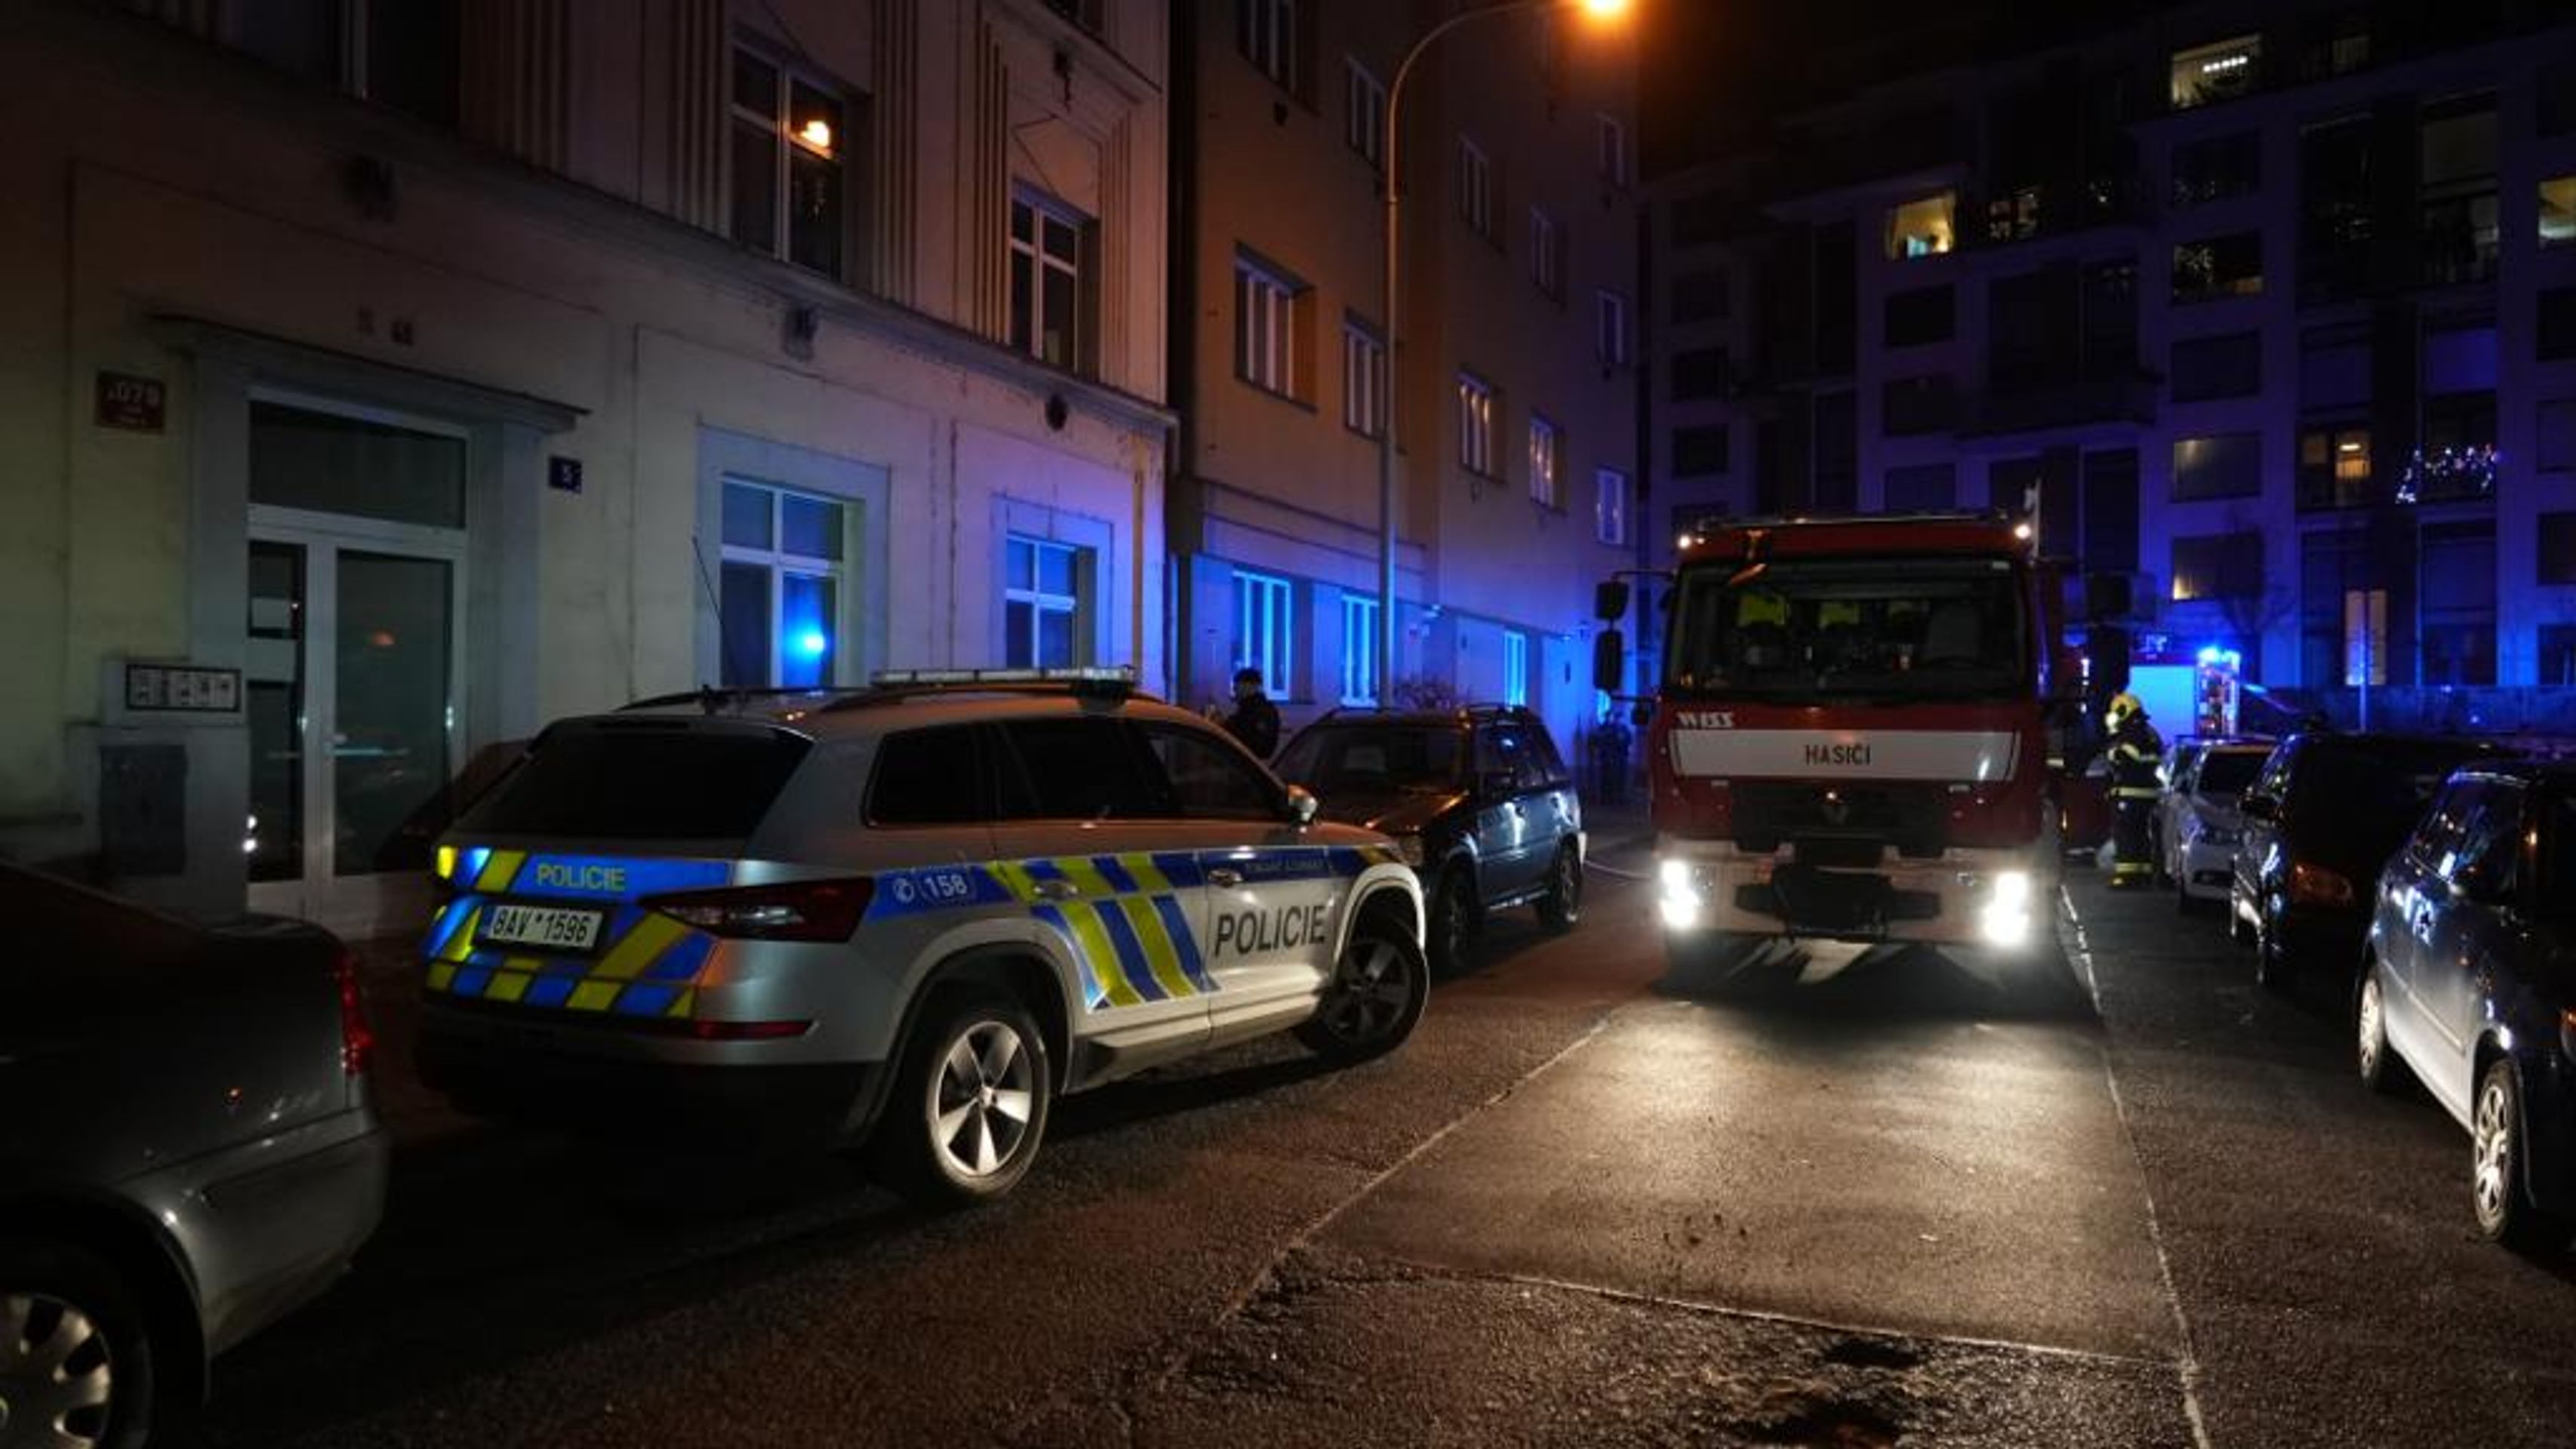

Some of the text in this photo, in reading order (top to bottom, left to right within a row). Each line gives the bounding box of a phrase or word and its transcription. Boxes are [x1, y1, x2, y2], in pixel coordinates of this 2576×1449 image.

[538, 863, 626, 891] POLICIE
[925, 874, 968, 897] 158
[1214, 906, 1326, 957] POLICIE
